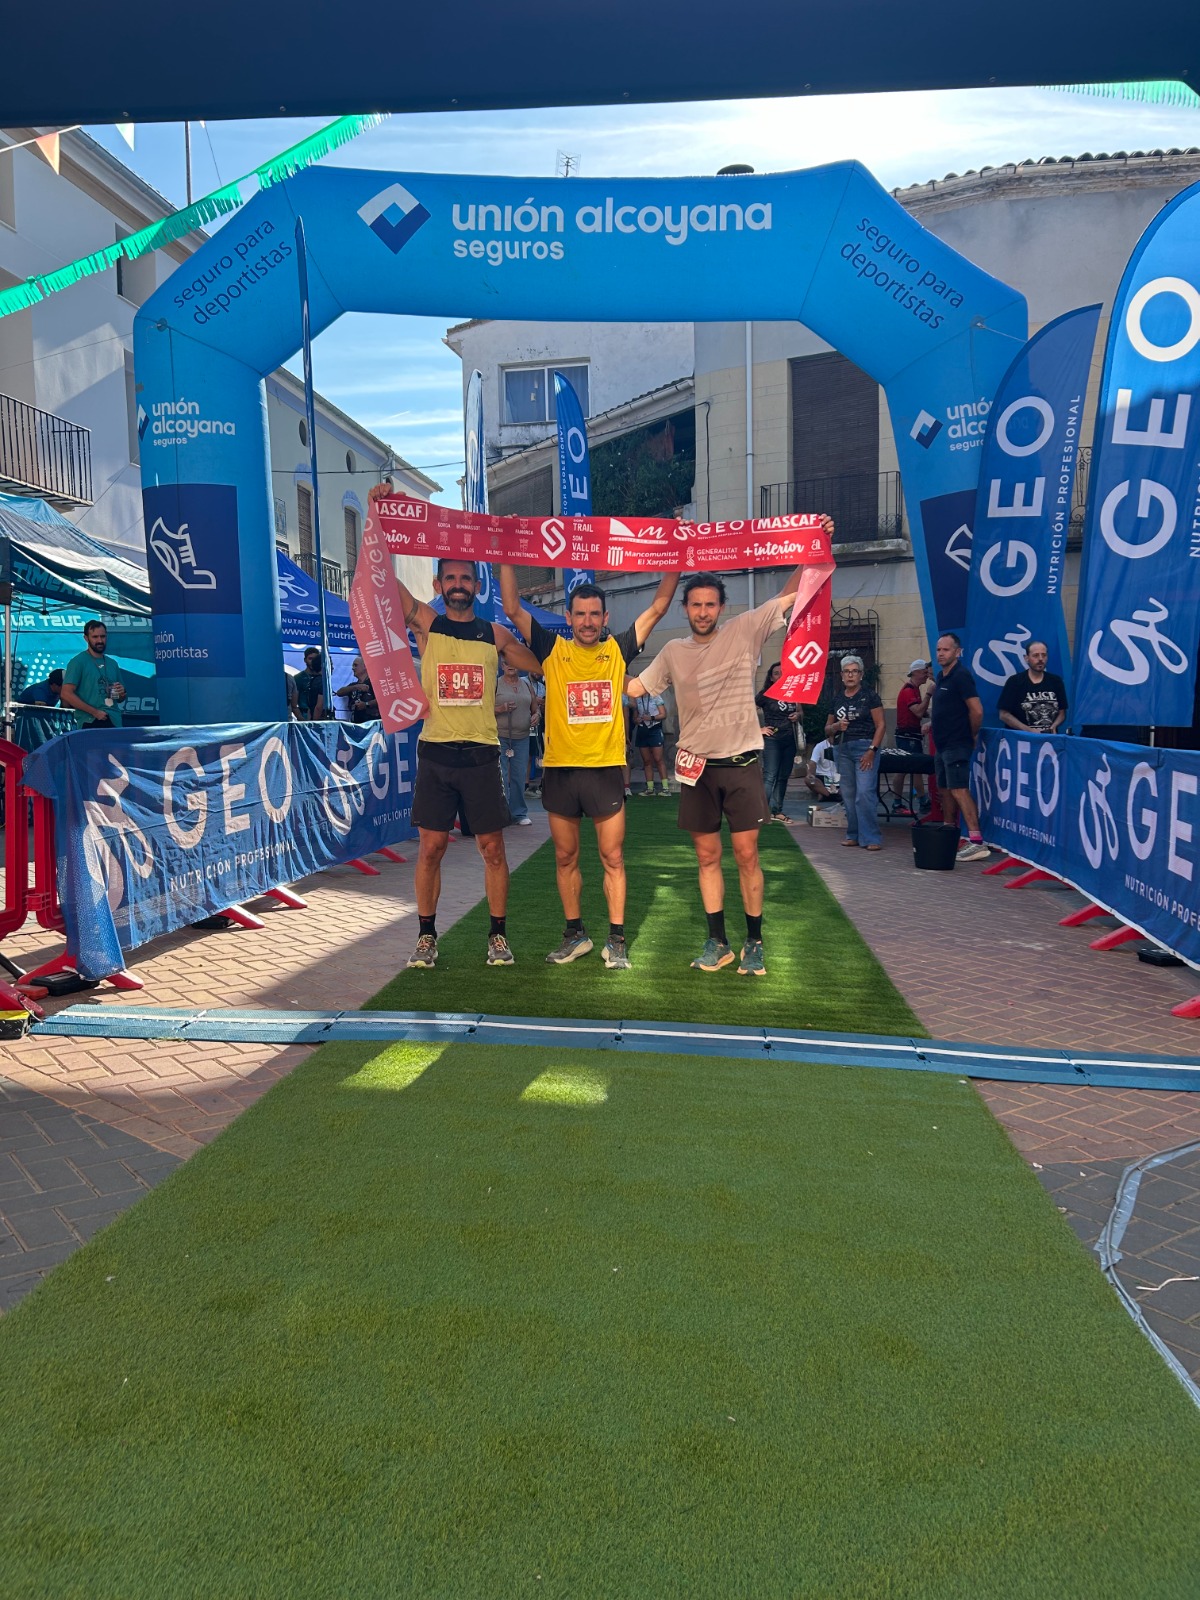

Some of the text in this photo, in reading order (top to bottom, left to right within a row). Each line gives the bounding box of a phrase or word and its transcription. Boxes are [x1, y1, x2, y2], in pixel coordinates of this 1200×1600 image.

[452, 197, 772, 245] unión alcoyana
[174, 219, 275, 309] seguro para
[453, 239, 564, 266] seguros
[856, 217, 966, 309] seguro para
[193, 240, 292, 324] deportistas
[840, 241, 945, 330] deportistas
[152, 397, 200, 416] unión
[946, 397, 994, 420] unió
[1100, 276, 1200, 559] GEO
[152, 414, 236, 438] alcoyana
[153, 436, 188, 448] seguros
[980, 396, 1055, 597] GEO
[1047, 394, 1080, 594] NUTRICIÓN PROFESIONAL
[573, 523, 593, 532] TRAIL
[697, 520, 744, 534] GEO
[757, 514, 817, 530] MASCAF
[571, 552, 589, 561] SETA
[572, 543, 600, 552] VALL DE
[625, 550, 679, 558] Mancomunitat
[697, 547, 738, 556] GENERALITAT
[697, 554, 737, 562] VALENCIANA
[282, 618, 321, 626] NUTRICIÓ
[452, 672, 469, 690] 94
[582, 690, 599, 707] 96
[1026, 691, 1057, 701] ALICE
[366, 732, 419, 800] GE
[995, 738, 1060, 817] GEO
[163, 737, 292, 850] GEO
[1125, 874, 1170, 911] NUTRICIÓN
